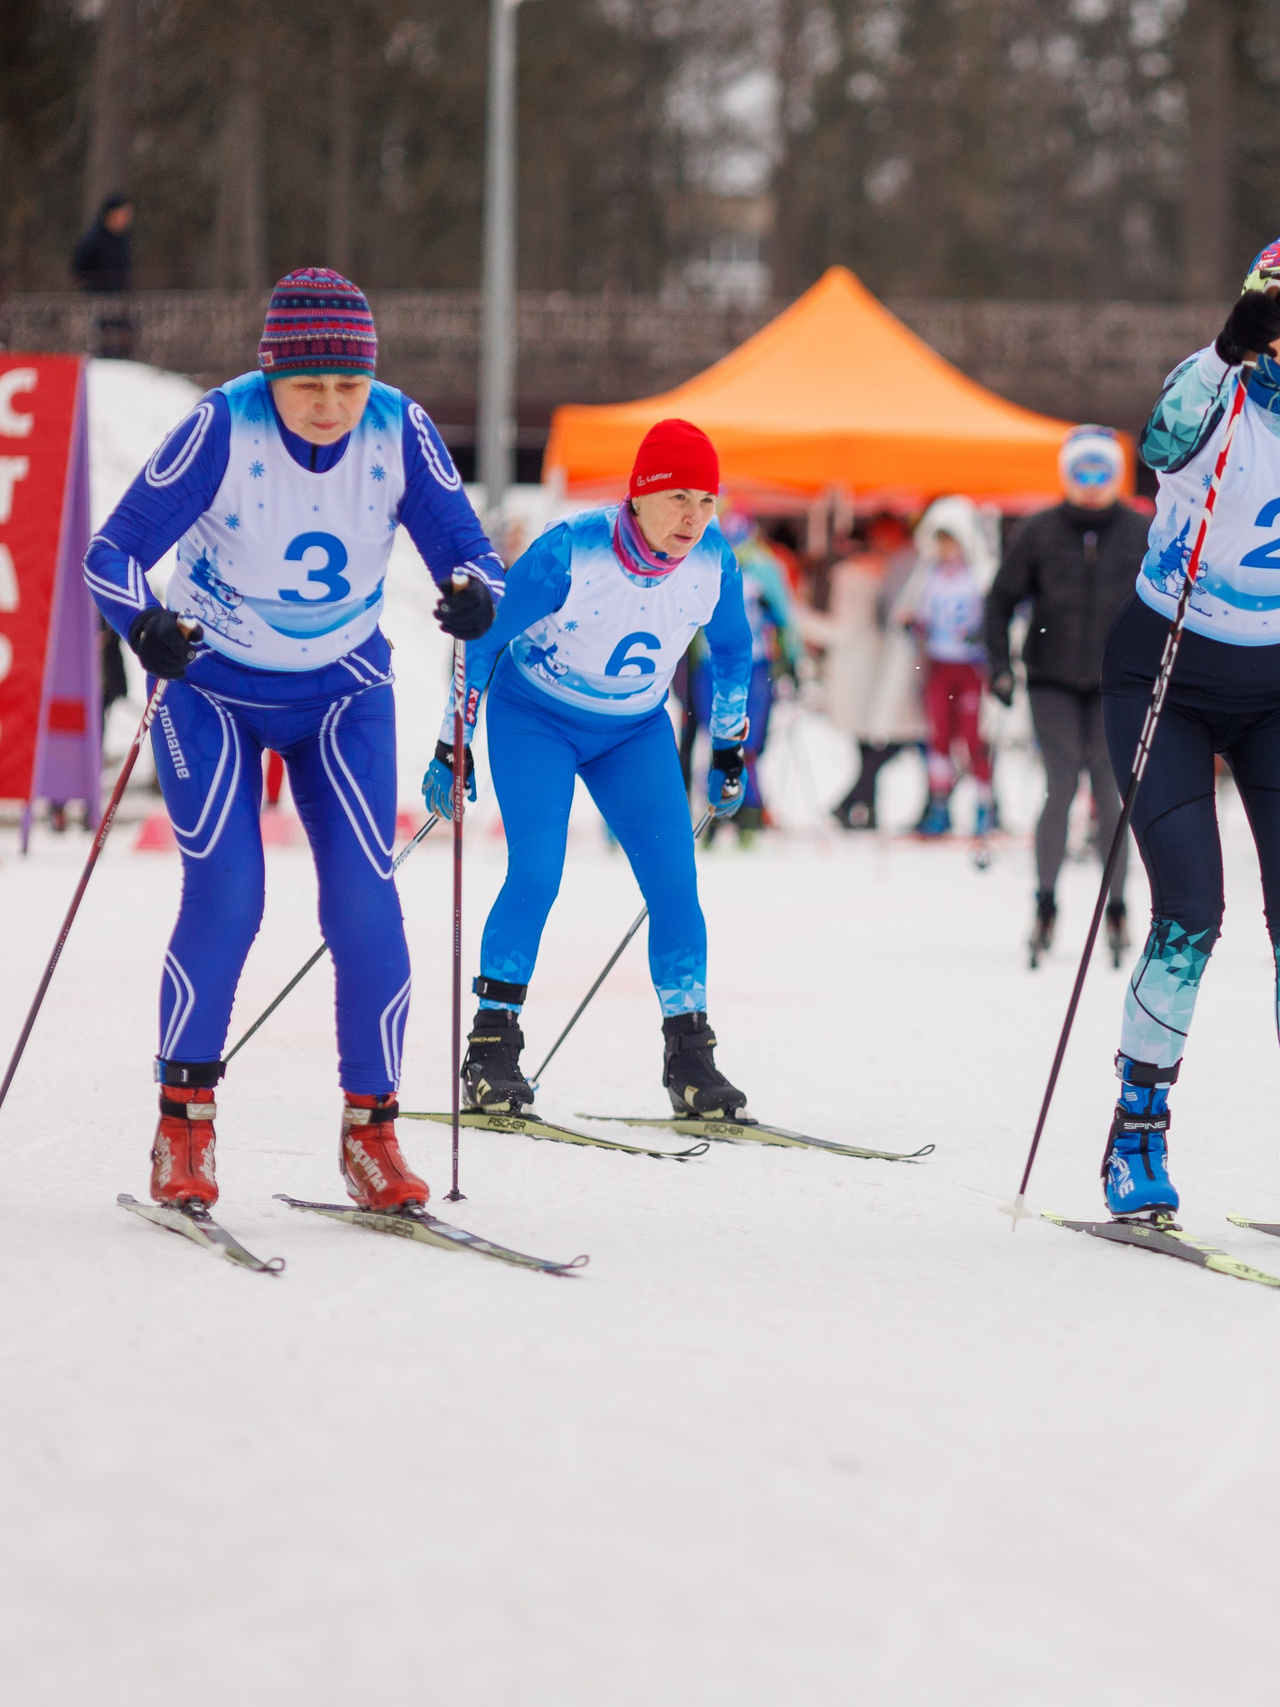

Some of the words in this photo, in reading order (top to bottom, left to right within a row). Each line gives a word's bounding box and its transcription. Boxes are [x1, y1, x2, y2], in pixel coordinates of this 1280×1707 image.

[278, 531, 348, 602] 3
[604, 631, 661, 677] 6
[158, 704, 190, 779] noname
[487, 1117, 526, 1130] FISCHER
[703, 1123, 744, 1136] FISCHER
[1123, 1120, 1167, 1130] SPINE
[345, 1134, 388, 1192] alpina
[1106, 1148, 1135, 1199] SPINE
[352, 1212, 415, 1238] FISCHER
